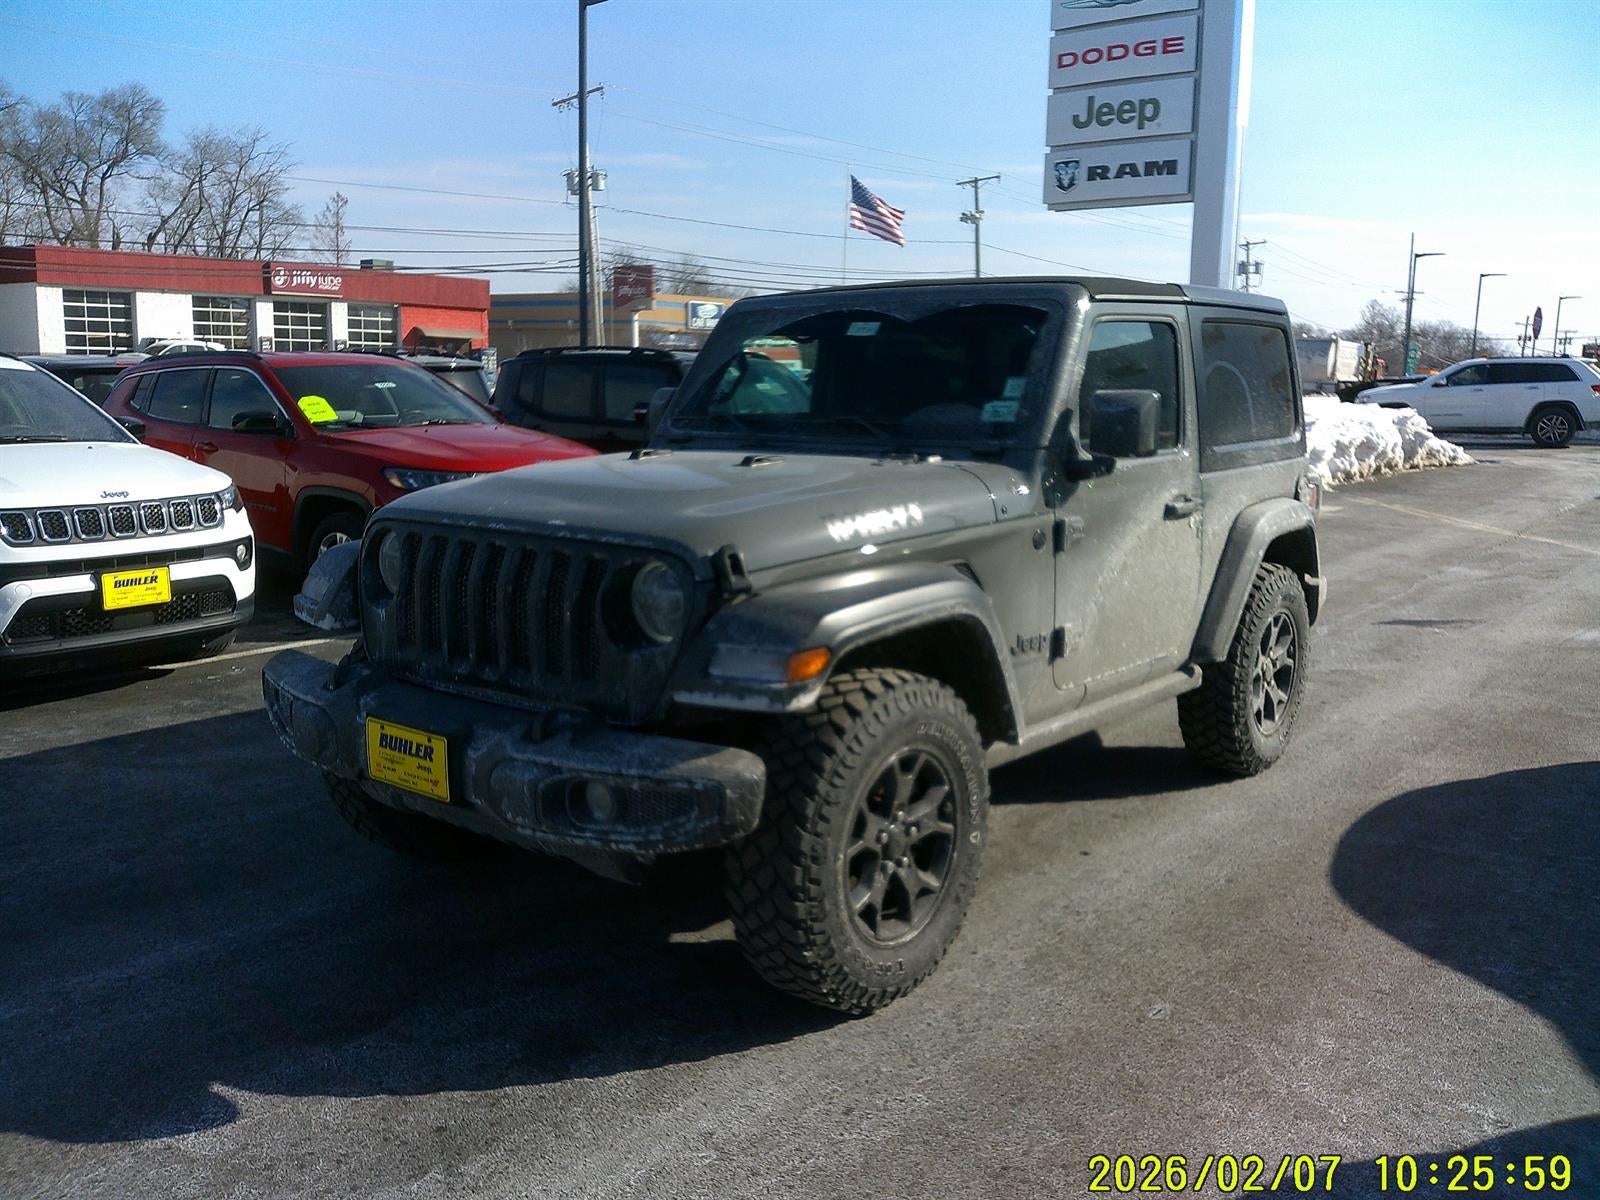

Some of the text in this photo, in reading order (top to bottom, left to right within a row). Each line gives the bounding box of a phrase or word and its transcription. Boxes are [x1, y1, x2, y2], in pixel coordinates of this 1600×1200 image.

[1056, 36, 1185, 69] DODGE
[1072, 95, 1161, 130] Jeep
[1086, 159, 1178, 182] RAM
[100, 490, 130, 498] Jeep
[113, 575, 159, 588] BUHLER
[1010, 633, 1047, 656] Jeep
[379, 732, 434, 762] BUHLER
